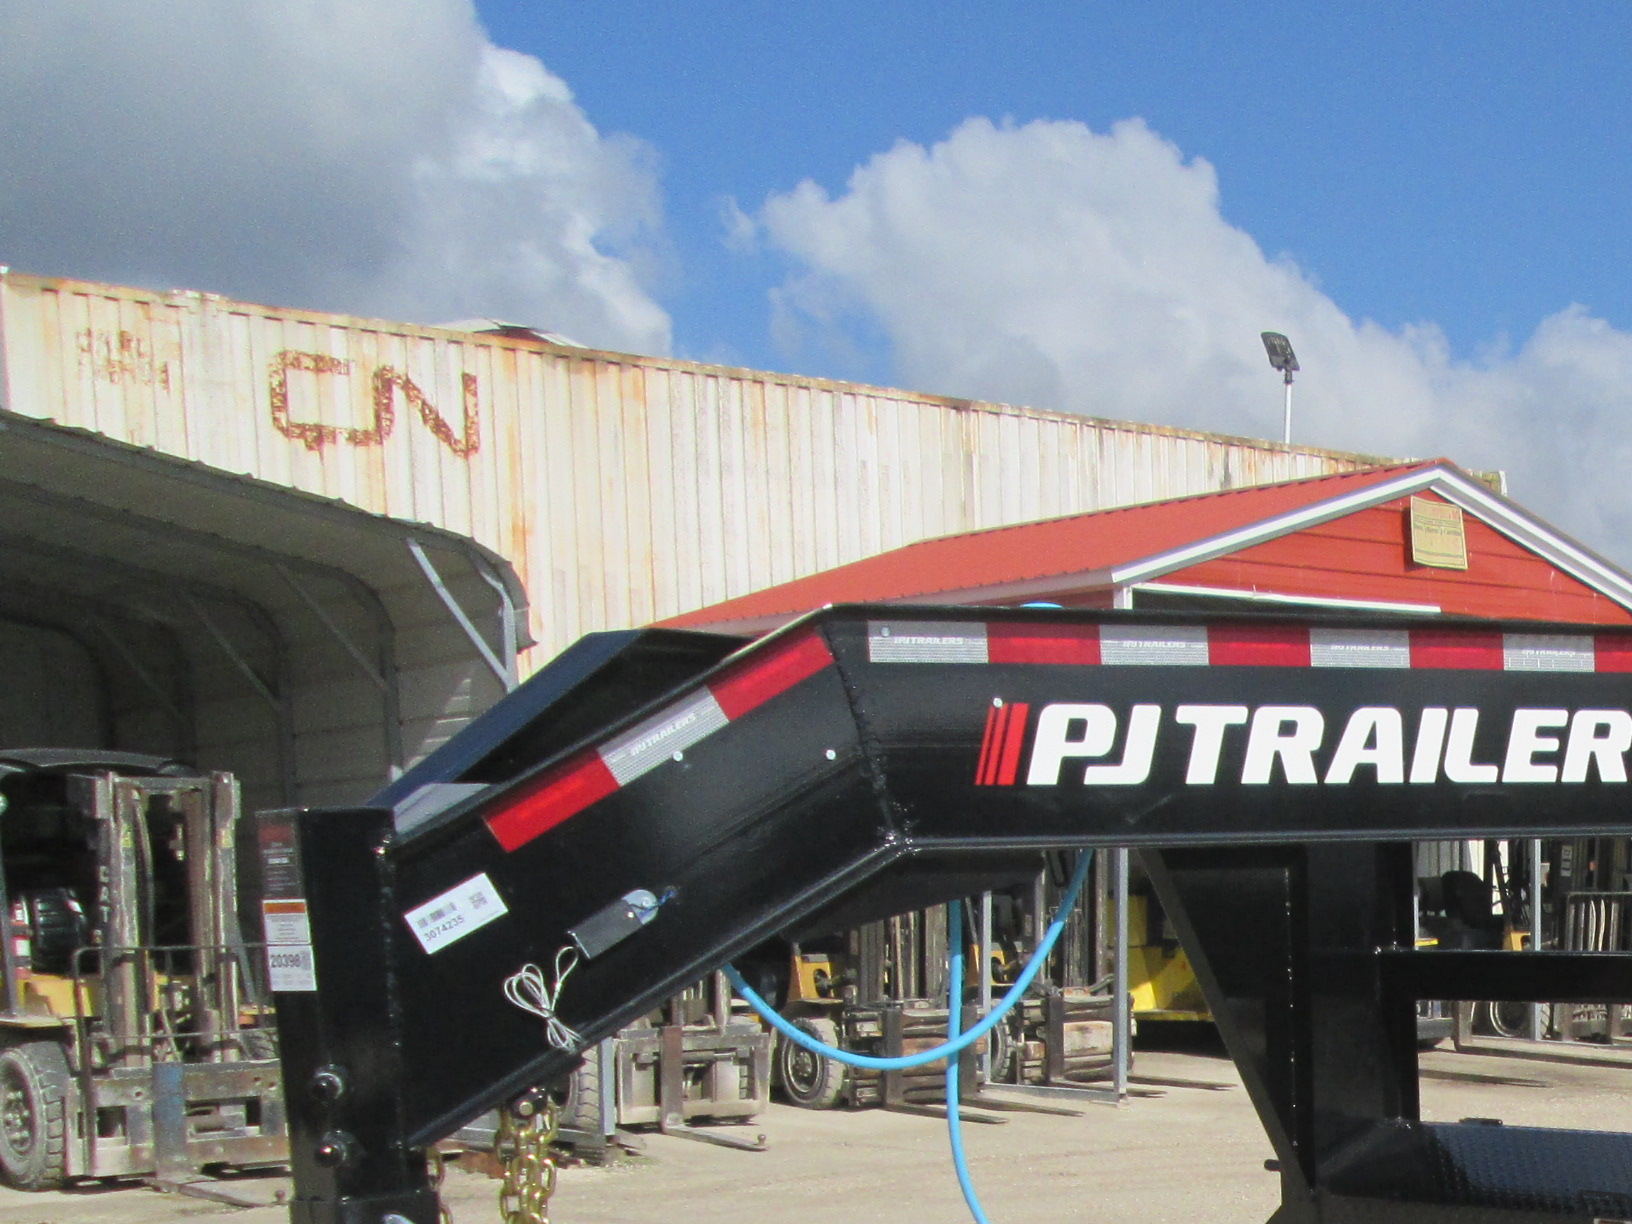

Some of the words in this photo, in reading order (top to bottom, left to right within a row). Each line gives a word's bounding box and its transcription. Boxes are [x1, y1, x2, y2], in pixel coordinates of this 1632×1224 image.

[269, 350, 479, 458] CN
[1026, 703, 1162, 787] PJ
[424, 914, 465, 942] 3074235
